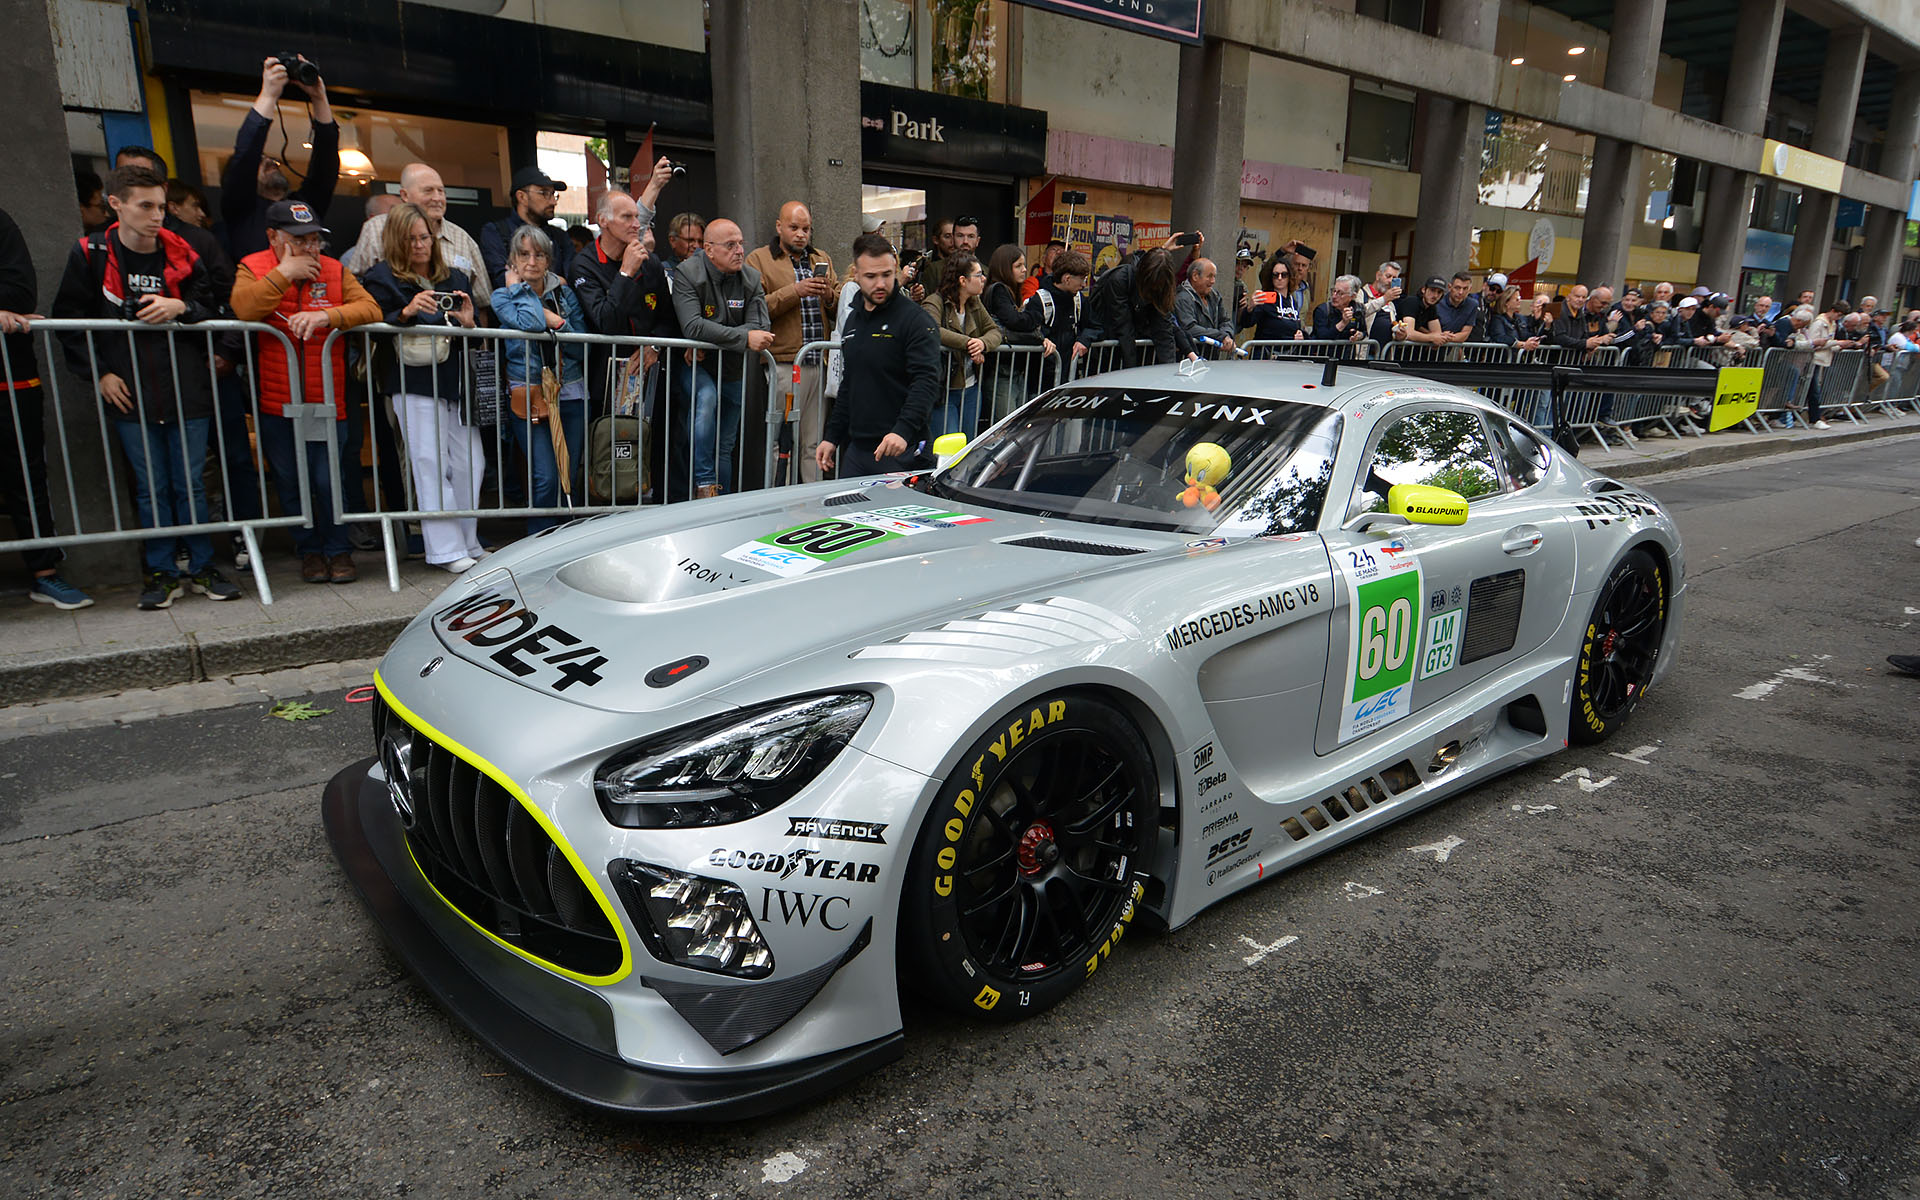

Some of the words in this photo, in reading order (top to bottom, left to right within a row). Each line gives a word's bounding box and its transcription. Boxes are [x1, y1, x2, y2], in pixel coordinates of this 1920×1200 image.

[1104, 0, 1154, 14] END
[891, 110, 944, 142] Park
[1098, 221, 1111, 234] PAS
[1042, 396, 1108, 409] IRON
[1166, 401, 1273, 425] LYNX
[1729, 392, 1757, 404] AMG
[1415, 506, 1464, 516] BLAUPUNKT
[774, 522, 887, 554] 60
[750, 548, 807, 564] WEC
[678, 558, 722, 583] IRON
[1166, 591, 1296, 651] MERCEDES-AMG
[1296, 583, 1319, 606] V8
[1359, 597, 1412, 681] 60
[1432, 615, 1454, 645] LM
[1425, 643, 1453, 673] GT3
[1355, 687, 1402, 720] WEC
[1194, 746, 1213, 769] OMP
[1206, 772, 1227, 789] Beta
[1201, 792, 1233, 814] CARRARO
[794, 822, 878, 839] RAVENOL
[1202, 811, 1239, 836] PRISMA
[760, 887, 851, 931] IWC
